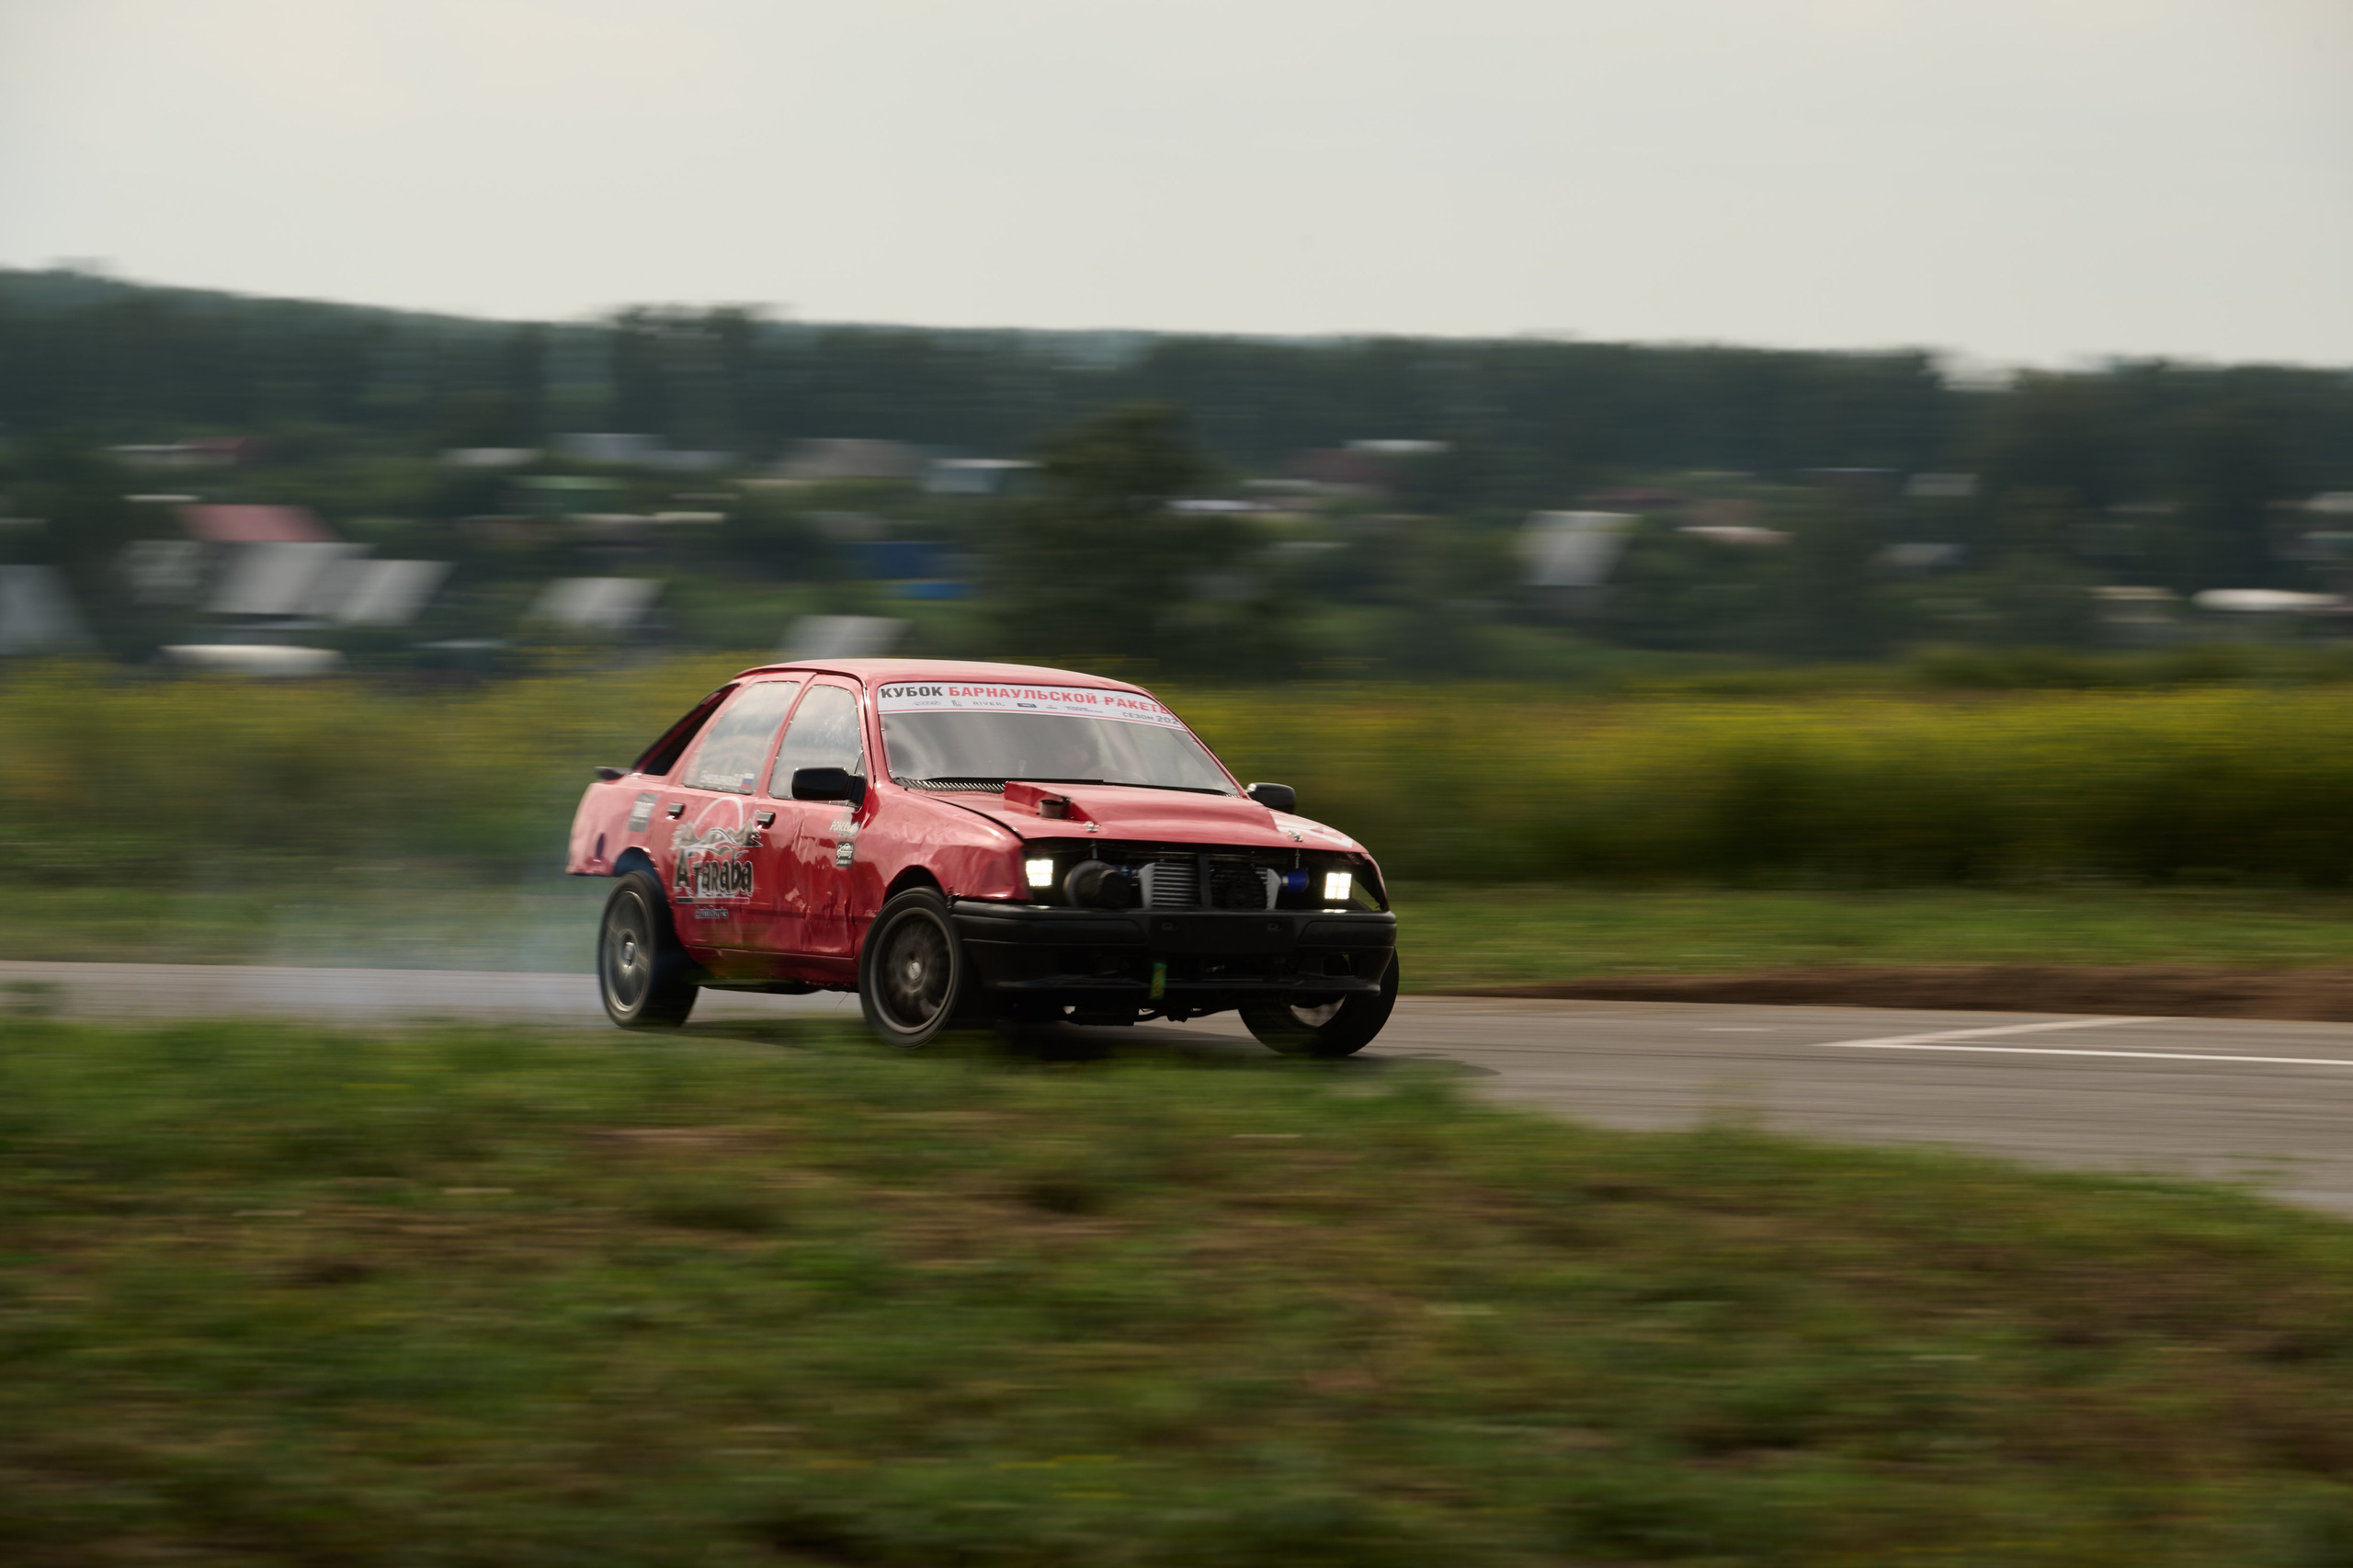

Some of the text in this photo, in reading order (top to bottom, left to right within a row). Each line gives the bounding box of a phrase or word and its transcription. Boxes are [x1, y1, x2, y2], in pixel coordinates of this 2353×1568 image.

[881, 687, 943, 698] КУБОК
[949, 687, 1097, 704] БАРНАУЛЬСКОЙ
[1122, 711, 1154, 722] СЕЗОН
